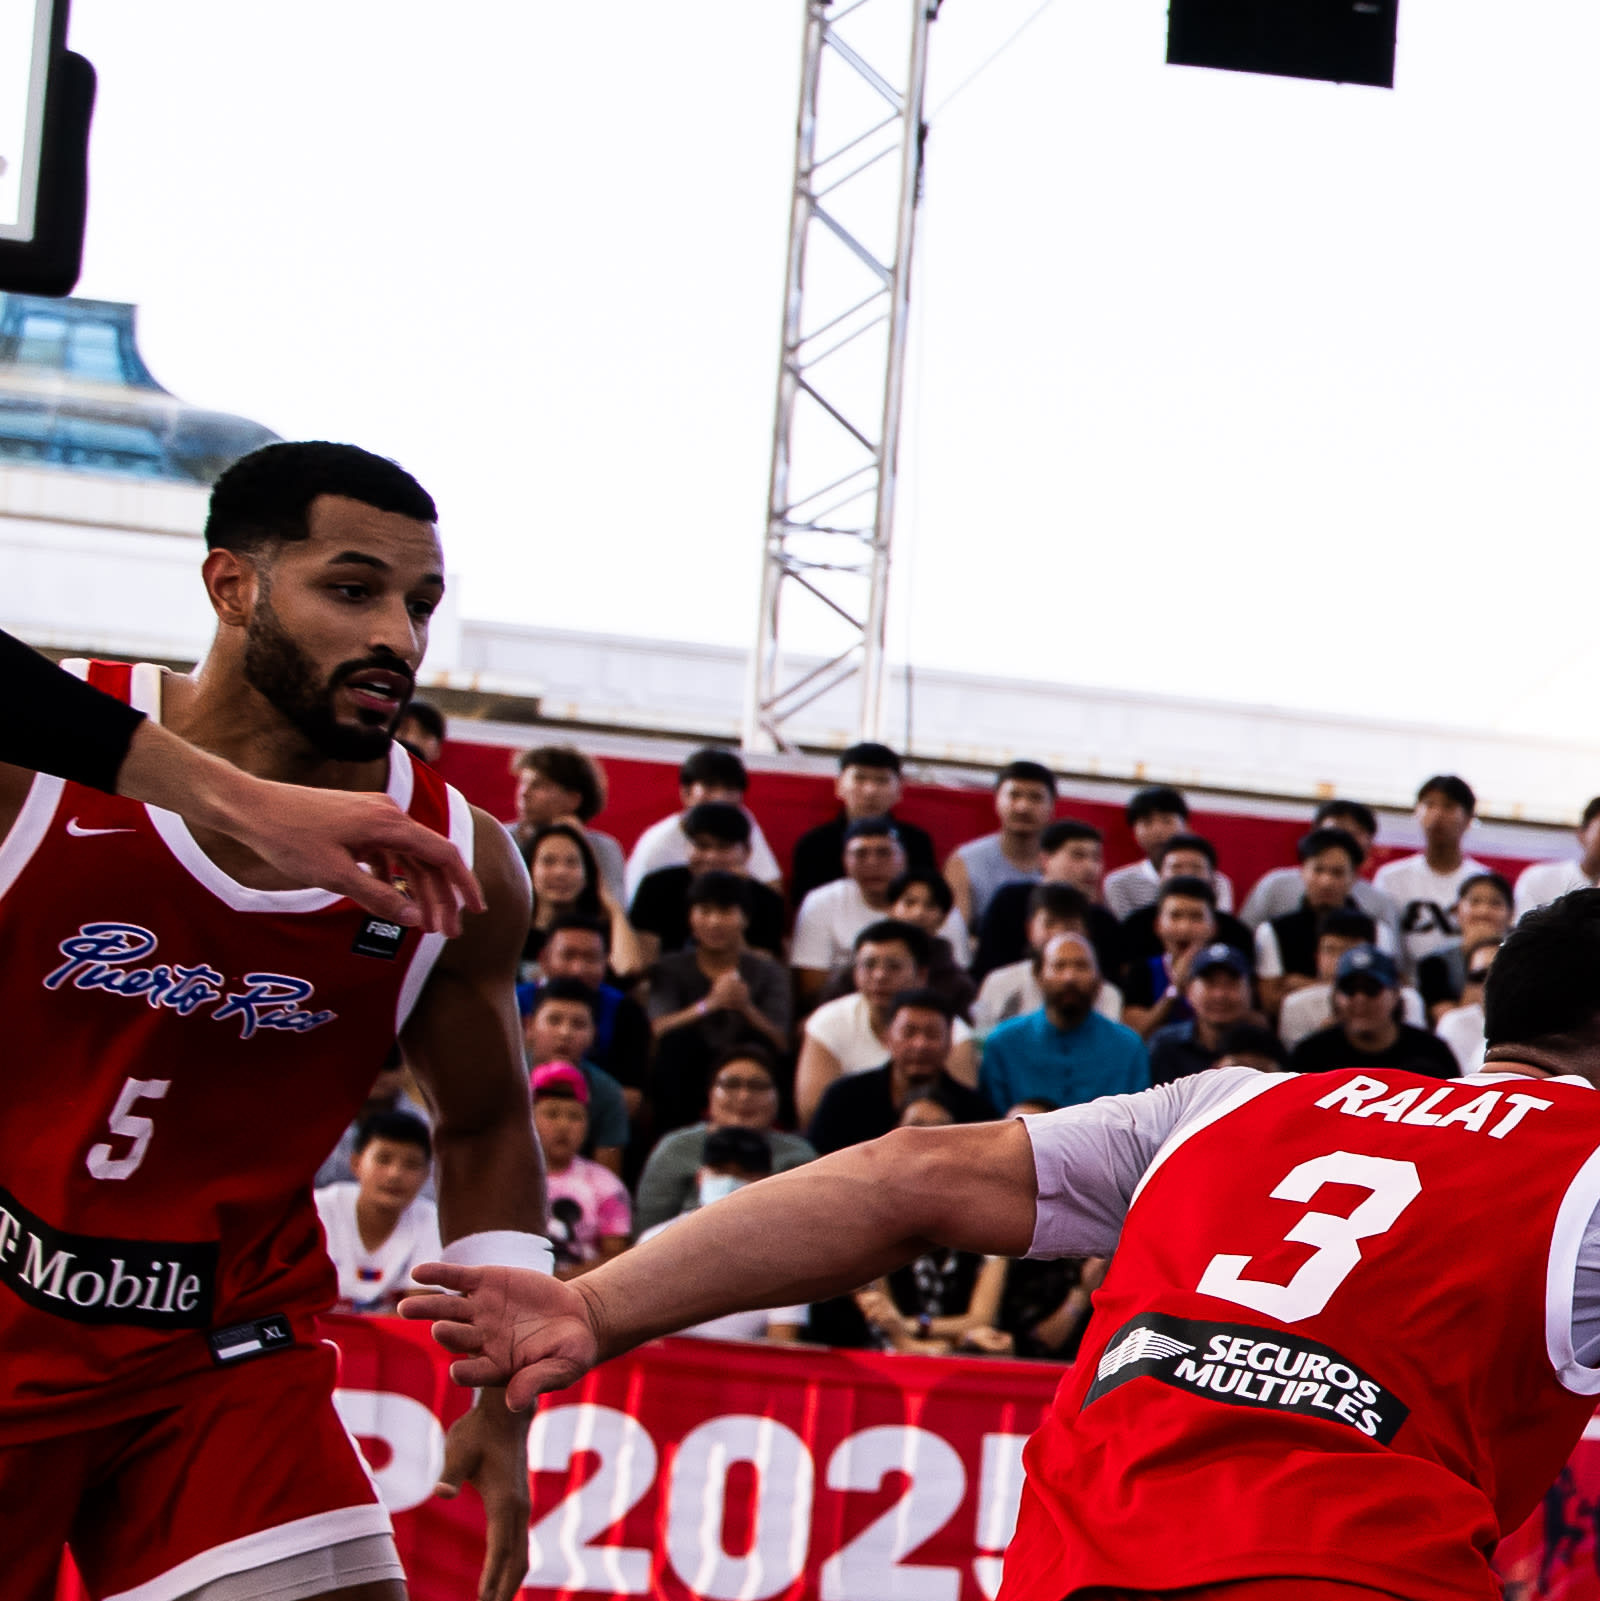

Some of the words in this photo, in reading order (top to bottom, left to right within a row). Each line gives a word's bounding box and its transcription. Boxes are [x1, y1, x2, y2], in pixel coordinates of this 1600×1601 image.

[366, 921, 401, 940] FIBA
[44, 922, 223, 1015] Puerto
[212, 972, 338, 1039] Rico
[85, 1077, 171, 1180] 5
[1314, 1075, 1554, 1139] RALAT
[1196, 1151, 1422, 1323] 3
[263, 1325, 286, 1340] XL
[1202, 1335, 1381, 1406] SEGUROS
[1173, 1358, 1382, 1439] MULTIPLES
